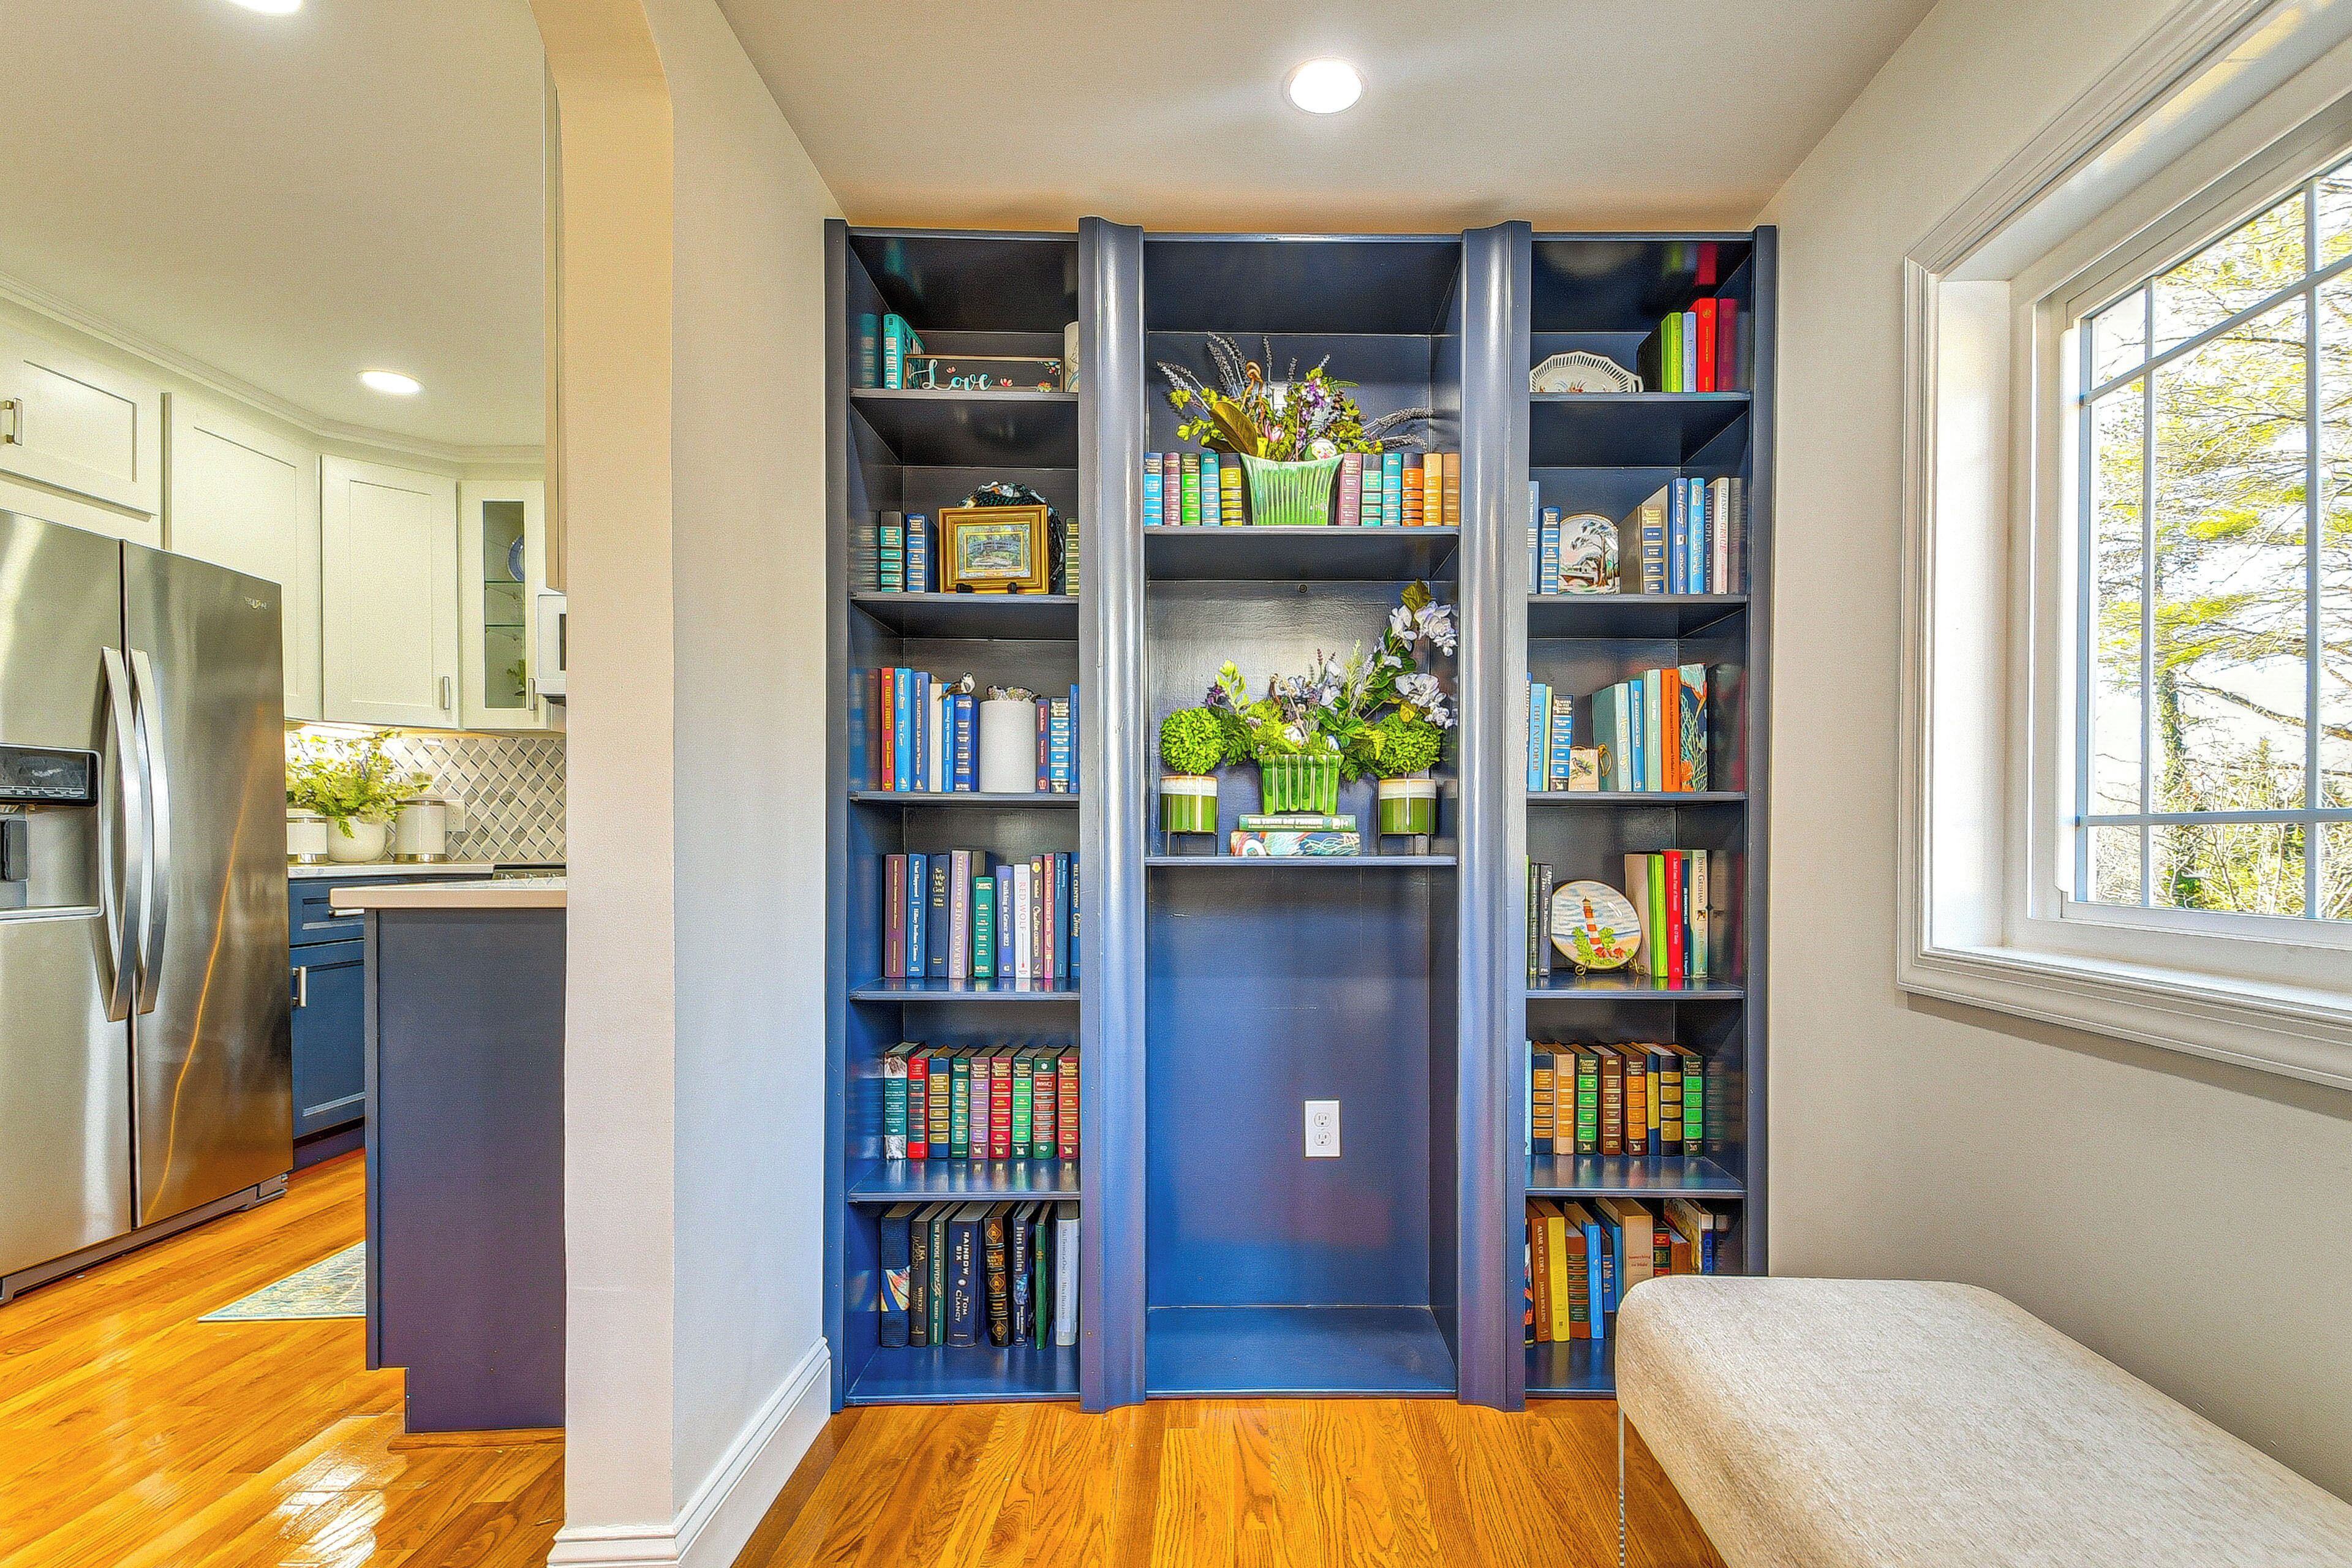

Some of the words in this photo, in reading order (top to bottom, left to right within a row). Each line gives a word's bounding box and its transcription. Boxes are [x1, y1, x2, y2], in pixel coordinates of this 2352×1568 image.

[886, 372, 898, 384] THE
[909, 359, 993, 391] Love
[1532, 704, 1541, 723] THE
[1532, 724, 1540, 772] EXPLORER
[1071, 912, 1081, 937] Giving
[953, 933, 962, 976] BARBARA
[1016, 1226, 1025, 1245] Blues
[911, 1235, 921, 1271] JACKSON
[1015, 1246, 1025, 1272] Dancing
[1537, 1246, 1544, 1256] OF
